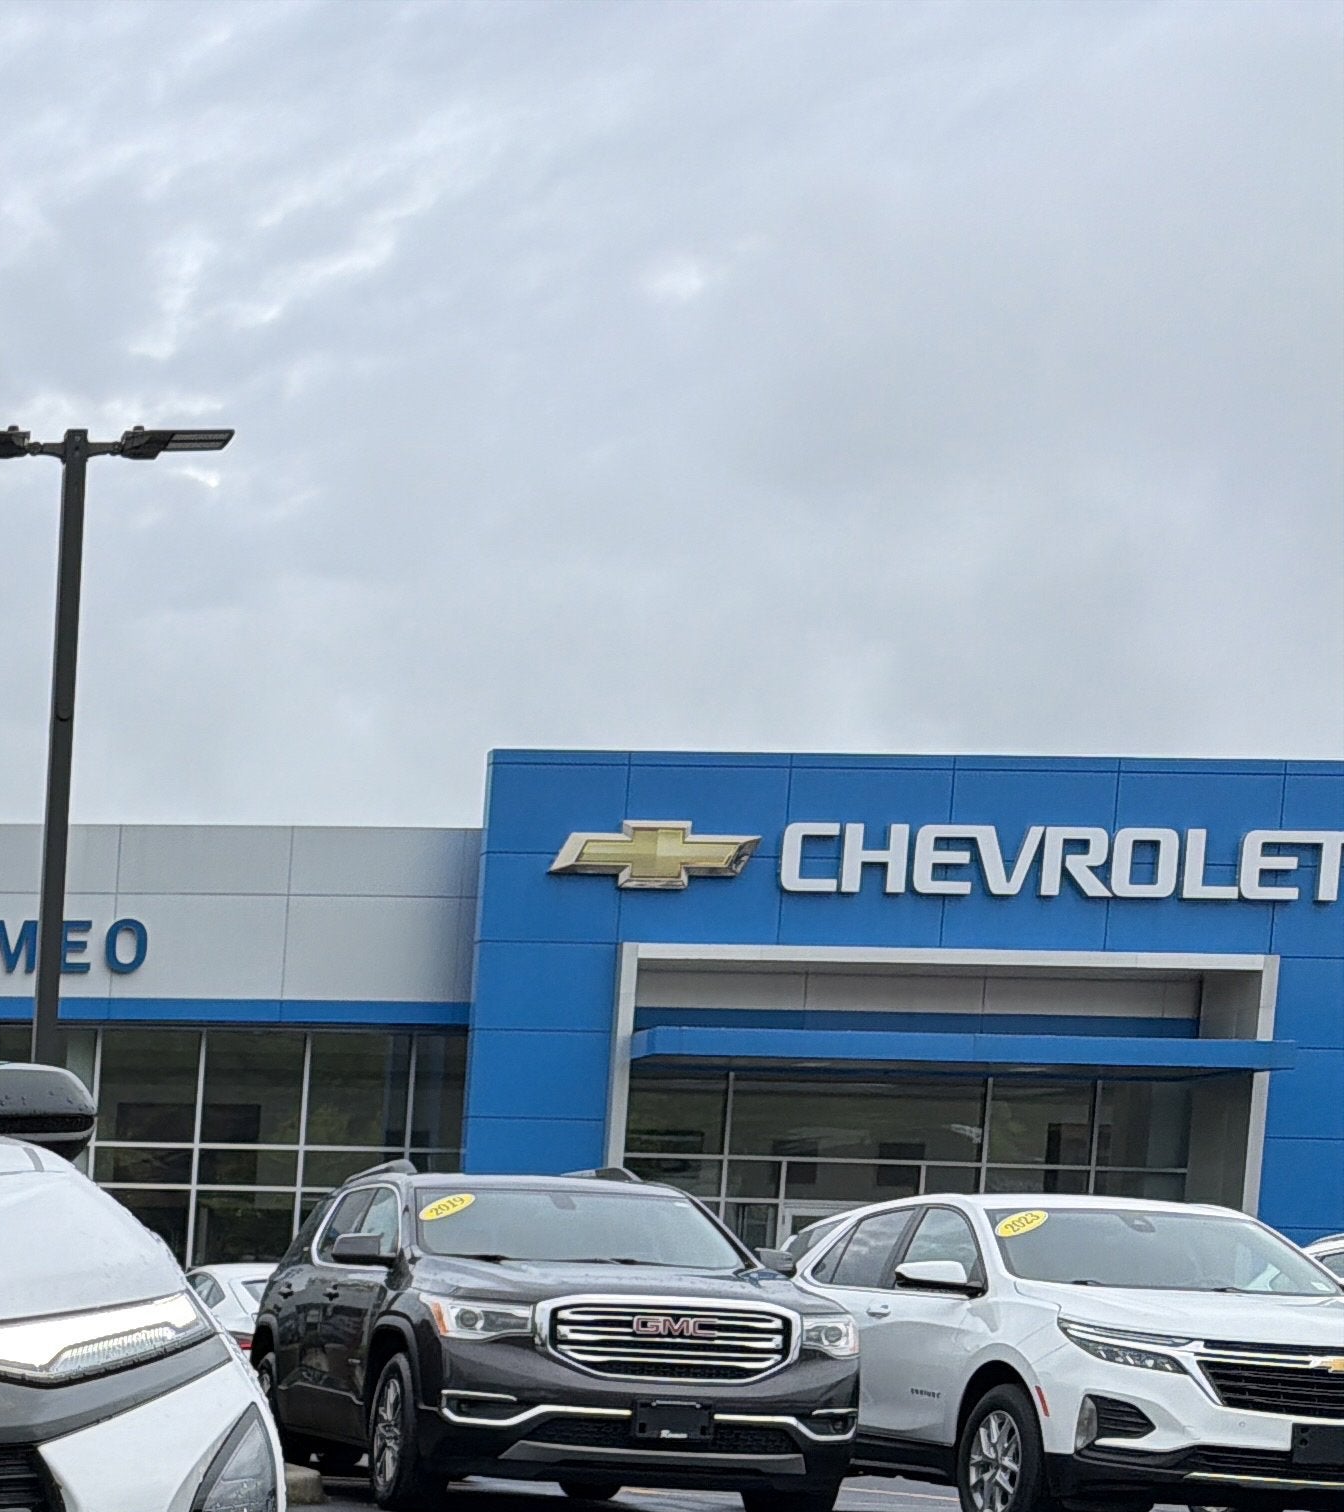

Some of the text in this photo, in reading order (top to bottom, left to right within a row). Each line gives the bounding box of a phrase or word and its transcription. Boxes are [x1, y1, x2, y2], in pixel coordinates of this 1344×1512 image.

[780, 821, 1344, 902] CHEVROLET
[429, 1196, 465, 1216] 2019
[1004, 1212, 1040, 1233] 2023
[632, 1315, 719, 1338] GMC
